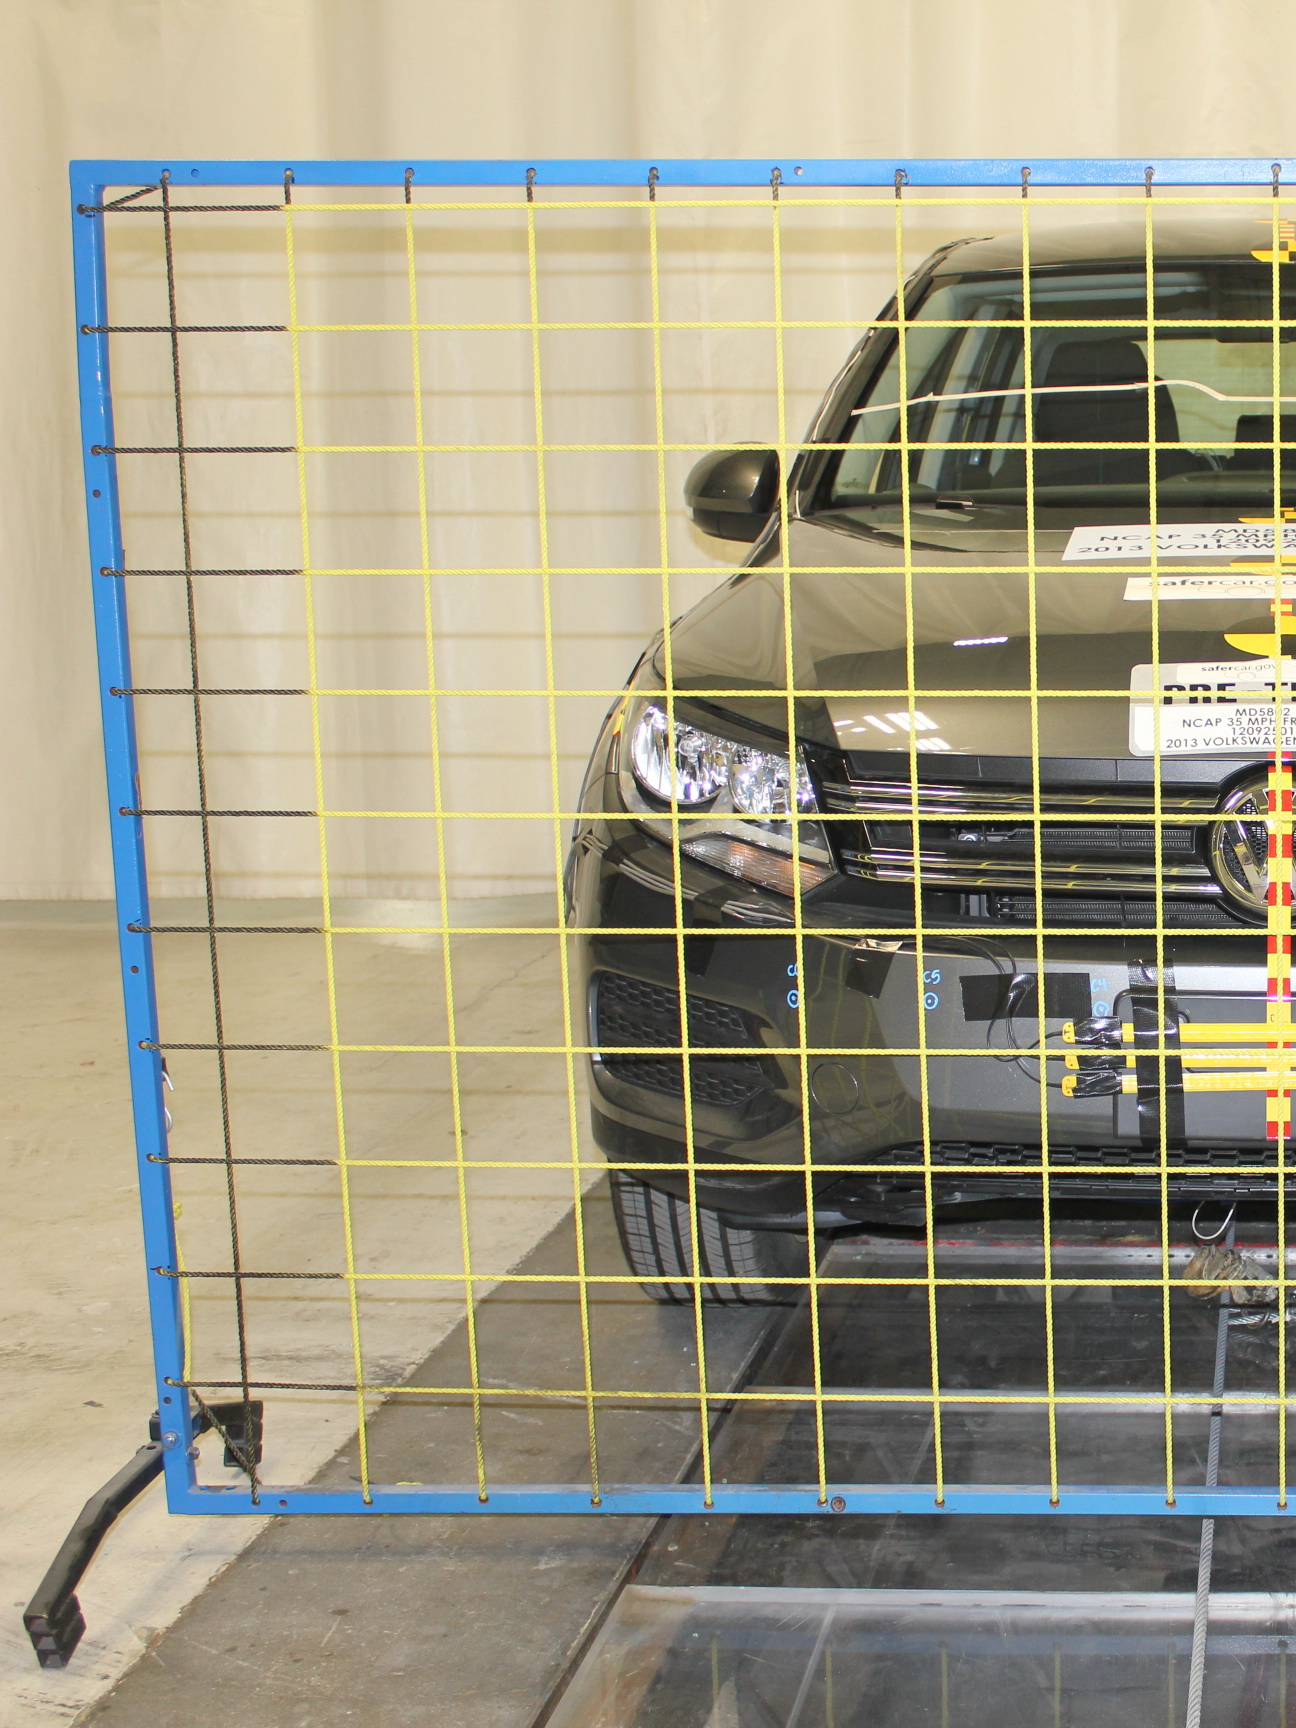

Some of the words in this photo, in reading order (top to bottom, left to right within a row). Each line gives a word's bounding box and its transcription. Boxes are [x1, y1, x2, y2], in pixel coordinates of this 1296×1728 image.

[1100, 533, 1181, 541] NCAP
[1077, 545, 1144, 553] 2013
[1182, 717, 1222, 728] NCAP
[1227, 717, 1243, 726] 35
[1247, 717, 1277, 726] MPH
[1232, 726, 1294, 736] 12092501
[1166, 738, 1198, 748] 2013
